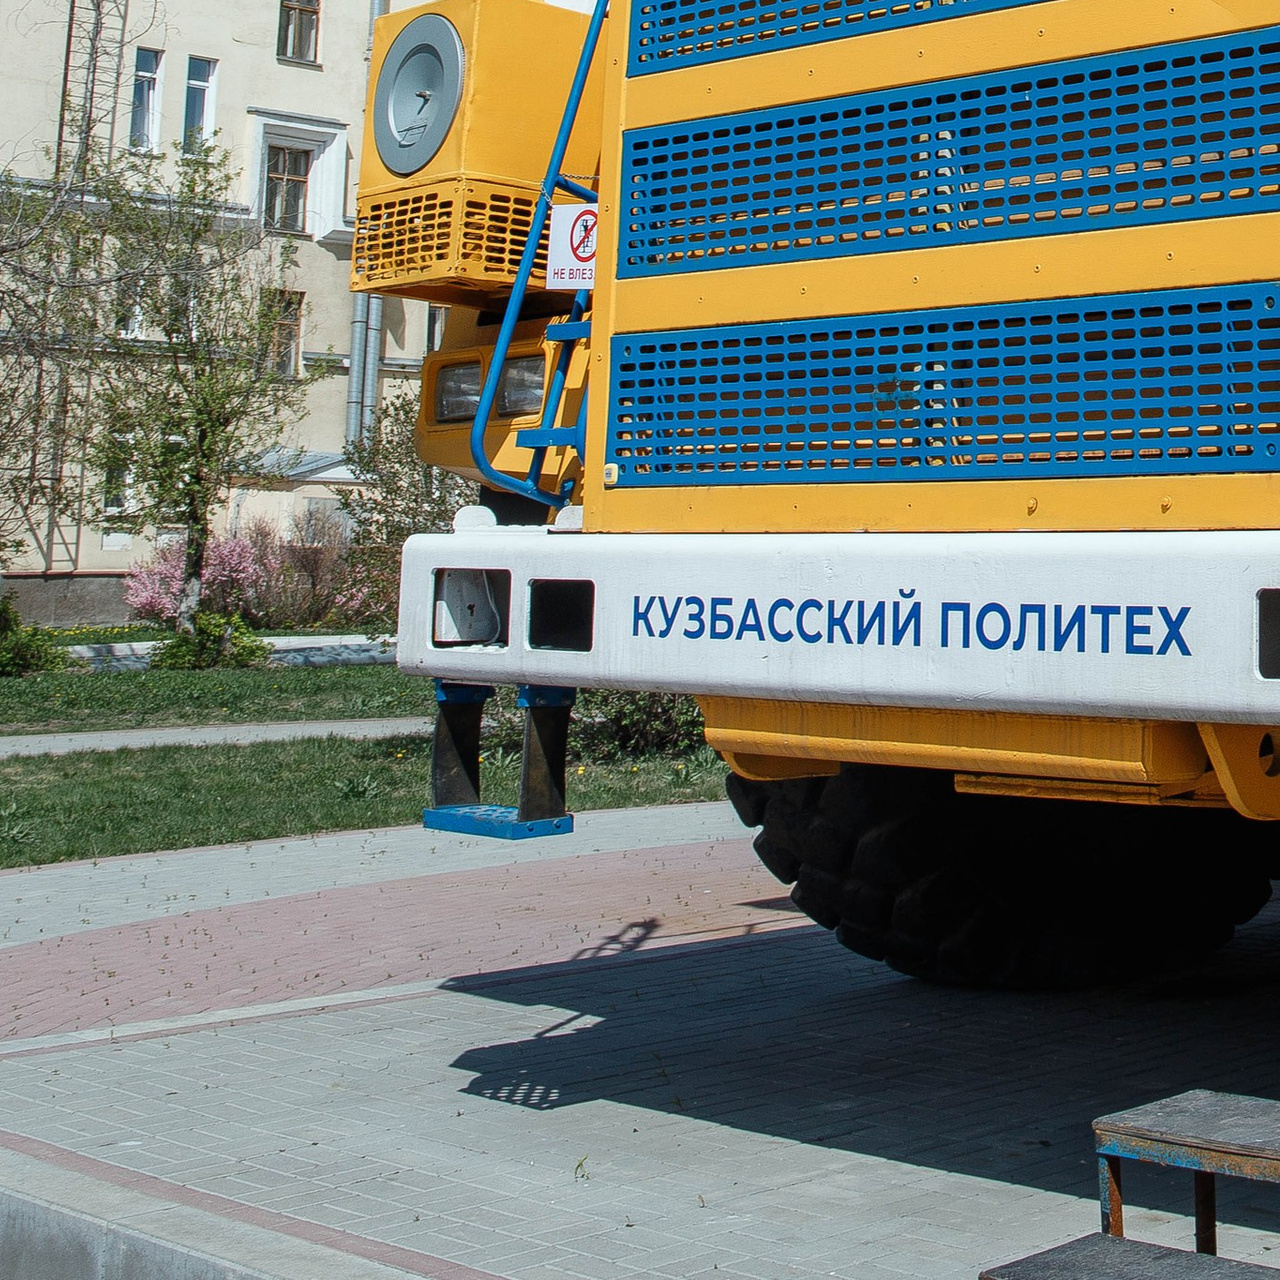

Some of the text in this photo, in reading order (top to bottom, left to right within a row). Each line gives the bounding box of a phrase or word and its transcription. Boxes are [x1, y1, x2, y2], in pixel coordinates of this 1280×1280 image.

[552, 268, 595, 280] НЕ ВЛЕЗ
[632, 588, 1193, 656] КУЗБАССКИЙ ПОЛИТЕХ
